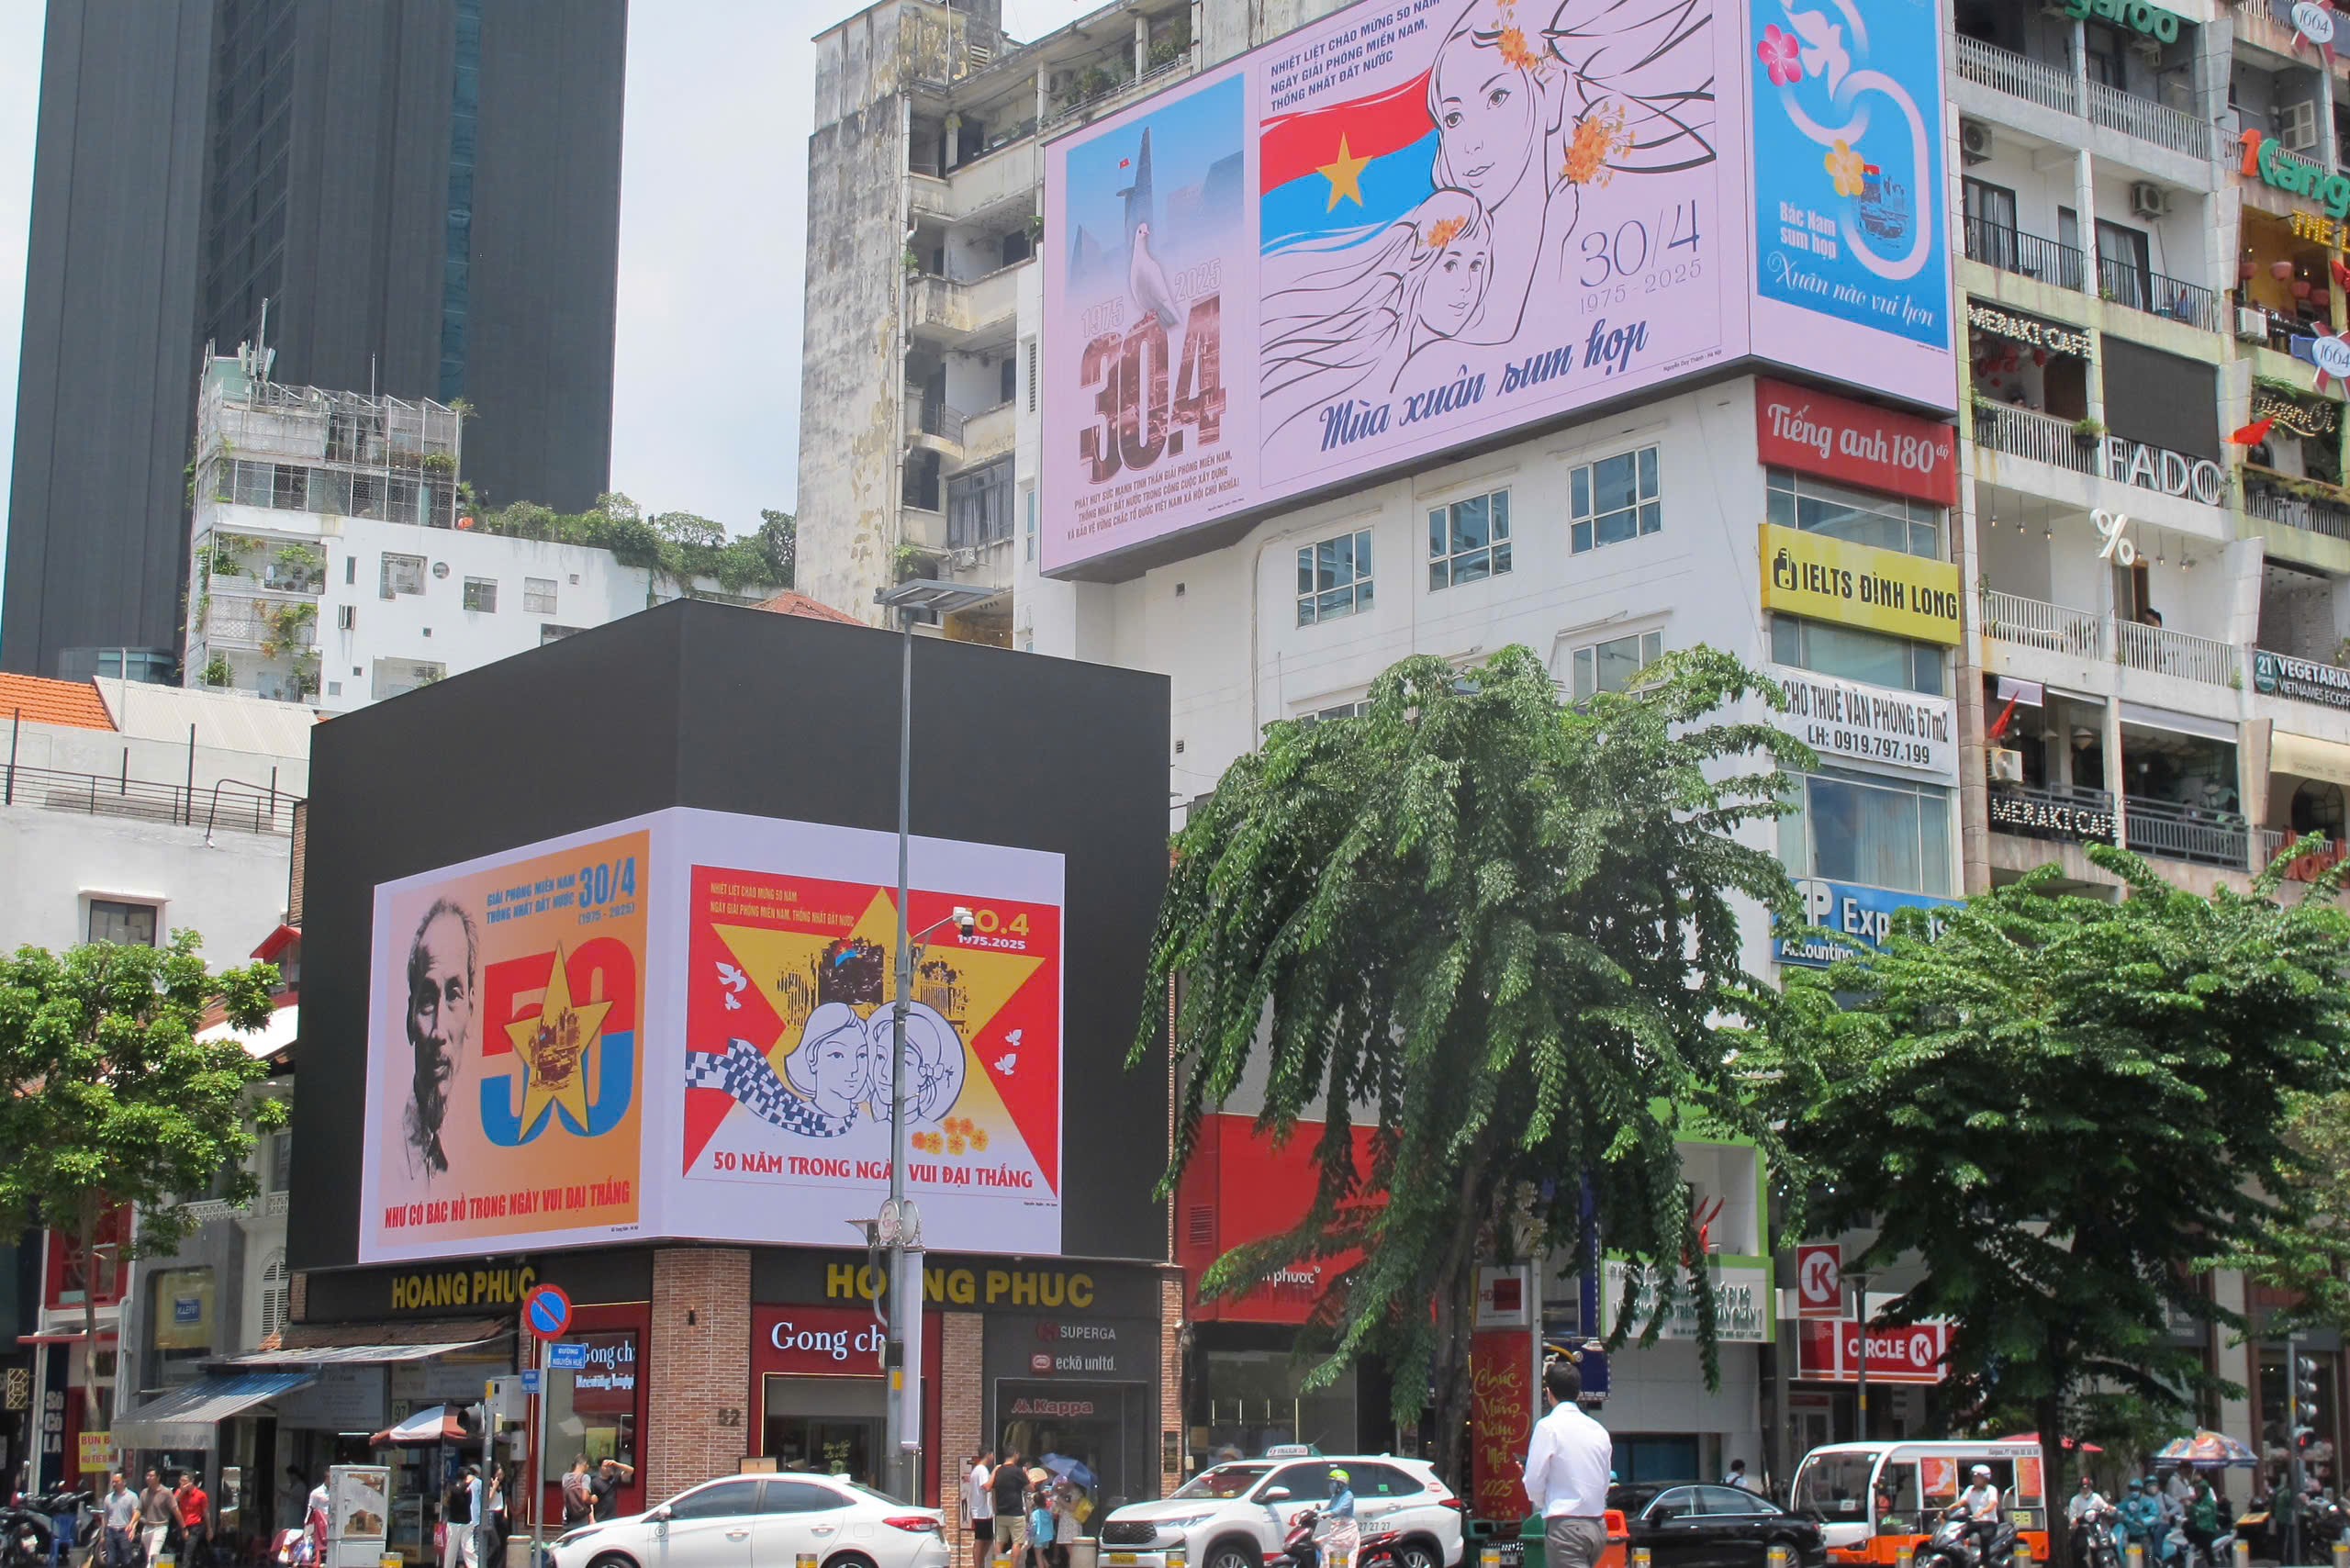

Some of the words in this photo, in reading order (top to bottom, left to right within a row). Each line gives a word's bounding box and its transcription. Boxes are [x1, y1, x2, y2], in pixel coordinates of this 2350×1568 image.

[1271, 53, 1301, 77] NHIỆT
[1304, 43, 1326, 62] LIỆT
[1329, 28, 1357, 51] CHÀO
[1360, 14, 1393, 38] MỪNG
[1396, 6, 1410, 22] 50
[2299, 8, 2330, 35] 1664
[1270, 73, 1298, 95] NGÀY
[1302, 59, 1323, 81] GIẢI
[1326, 46, 1363, 72] PHÓNG
[1366, 31, 1395, 53] MIỀN
[1271, 88, 1305, 112] THỐNG
[1308, 73, 1337, 97] NHẤT
[1339, 63, 1360, 83] ĐẤT
[1362, 50, 1393, 73] NƯỚC
[1779, 200, 1804, 227] Bác
[1807, 209, 1836, 237] Nam
[2291, 207, 2335, 246] THE
[1579, 199, 1701, 288] 30/4
[1780, 227, 1808, 251] sum
[1812, 232, 1837, 261] họp
[1175, 257, 1222, 305] 2025
[1580, 286, 1627, 315] 1975
[1646, 257, 1703, 294] 2025
[1767, 251, 1829, 296] Xuân
[1833, 283, 1867, 307] nào
[1872, 294, 1898, 317] vui
[1902, 294, 1934, 328] hơn
[1081, 296, 1125, 338] 1975
[2319, 344, 2350, 376] 1664
[1080, 293, 1226, 485] 30.4
[1319, 398, 1390, 453] Mùa
[1399, 364, 1486, 426] xuân
[1496, 341, 1572, 397] sum
[1583, 318, 1650, 376] họp
[1768, 403, 1833, 459] Tiếng
[1892, 434, 1934, 474] 180
[1936, 443, 1949, 460] độ
[1802, 562, 1853, 599] IELTS
[1860, 571, 1905, 610] ĐÌNH
[1911, 585, 1958, 621] LONG
[2258, 655, 2272, 675] 21
[2277, 656, 2350, 689] VEGETARIA
[1783, 679, 1808, 717] CHO
[1810, 683, 1843, 723] THUÊ
[1845, 689, 1871, 728] VĂN
[1873, 692, 1916, 736] PHÒNG
[1807, 723, 1830, 746] LH:
[1834, 729, 1930, 765] 0919.797.199
[1992, 798, 2072, 831] MERAKI
[487, 888, 503, 907] GIẢI
[556, 873, 576, 890] NAM
[578, 856, 637, 909] 30/4
[957, 934, 1026, 950] 1975.2025
[713, 1150, 736, 1171] 50
[741, 1151, 783, 1175] NĂM
[788, 1156, 851, 1178] TRONG
[856, 1159, 892, 1182] NGÀ
[908, 1163, 937, 1183] VUI
[942, 1165, 970, 1189] ĐẠI
[975, 1162, 1034, 1189] THẮNG
[385, 1203, 408, 1229] NHƯ
[409, 1201, 423, 1226] CÓ
[426, 1198, 448, 1224] BÁC
[451, 1192, 466, 1222] HỒ
[469, 1195, 506, 1220] TRONG
[509, 1188, 540, 1216] NGÀY
[542, 1188, 563, 1213] VUI
[565, 1185, 586, 1214] ĐẠI
[589, 1176, 632, 1207] THẮNG
[392, 1272, 469, 1309] HOANG
[473, 1266, 536, 1305] PHUC
[827, 1263, 976, 1305] HONG
[985, 1270, 1094, 1308] PHUC
[1810, 1262, 1836, 1292] K
[771, 1321, 848, 1361] Gong
[1060, 1325, 1116, 1341] SUPERGA
[1848, 1338, 1905, 1360] CRCLE
[1034, 1398, 1093, 1416] Kappa
[43, 1433, 62, 1453] LA
[1481, 1478, 1515, 1498] 2025
[1370, 1521, 1379, 1531] 27
[1382, 1521, 1391, 1531] 27
